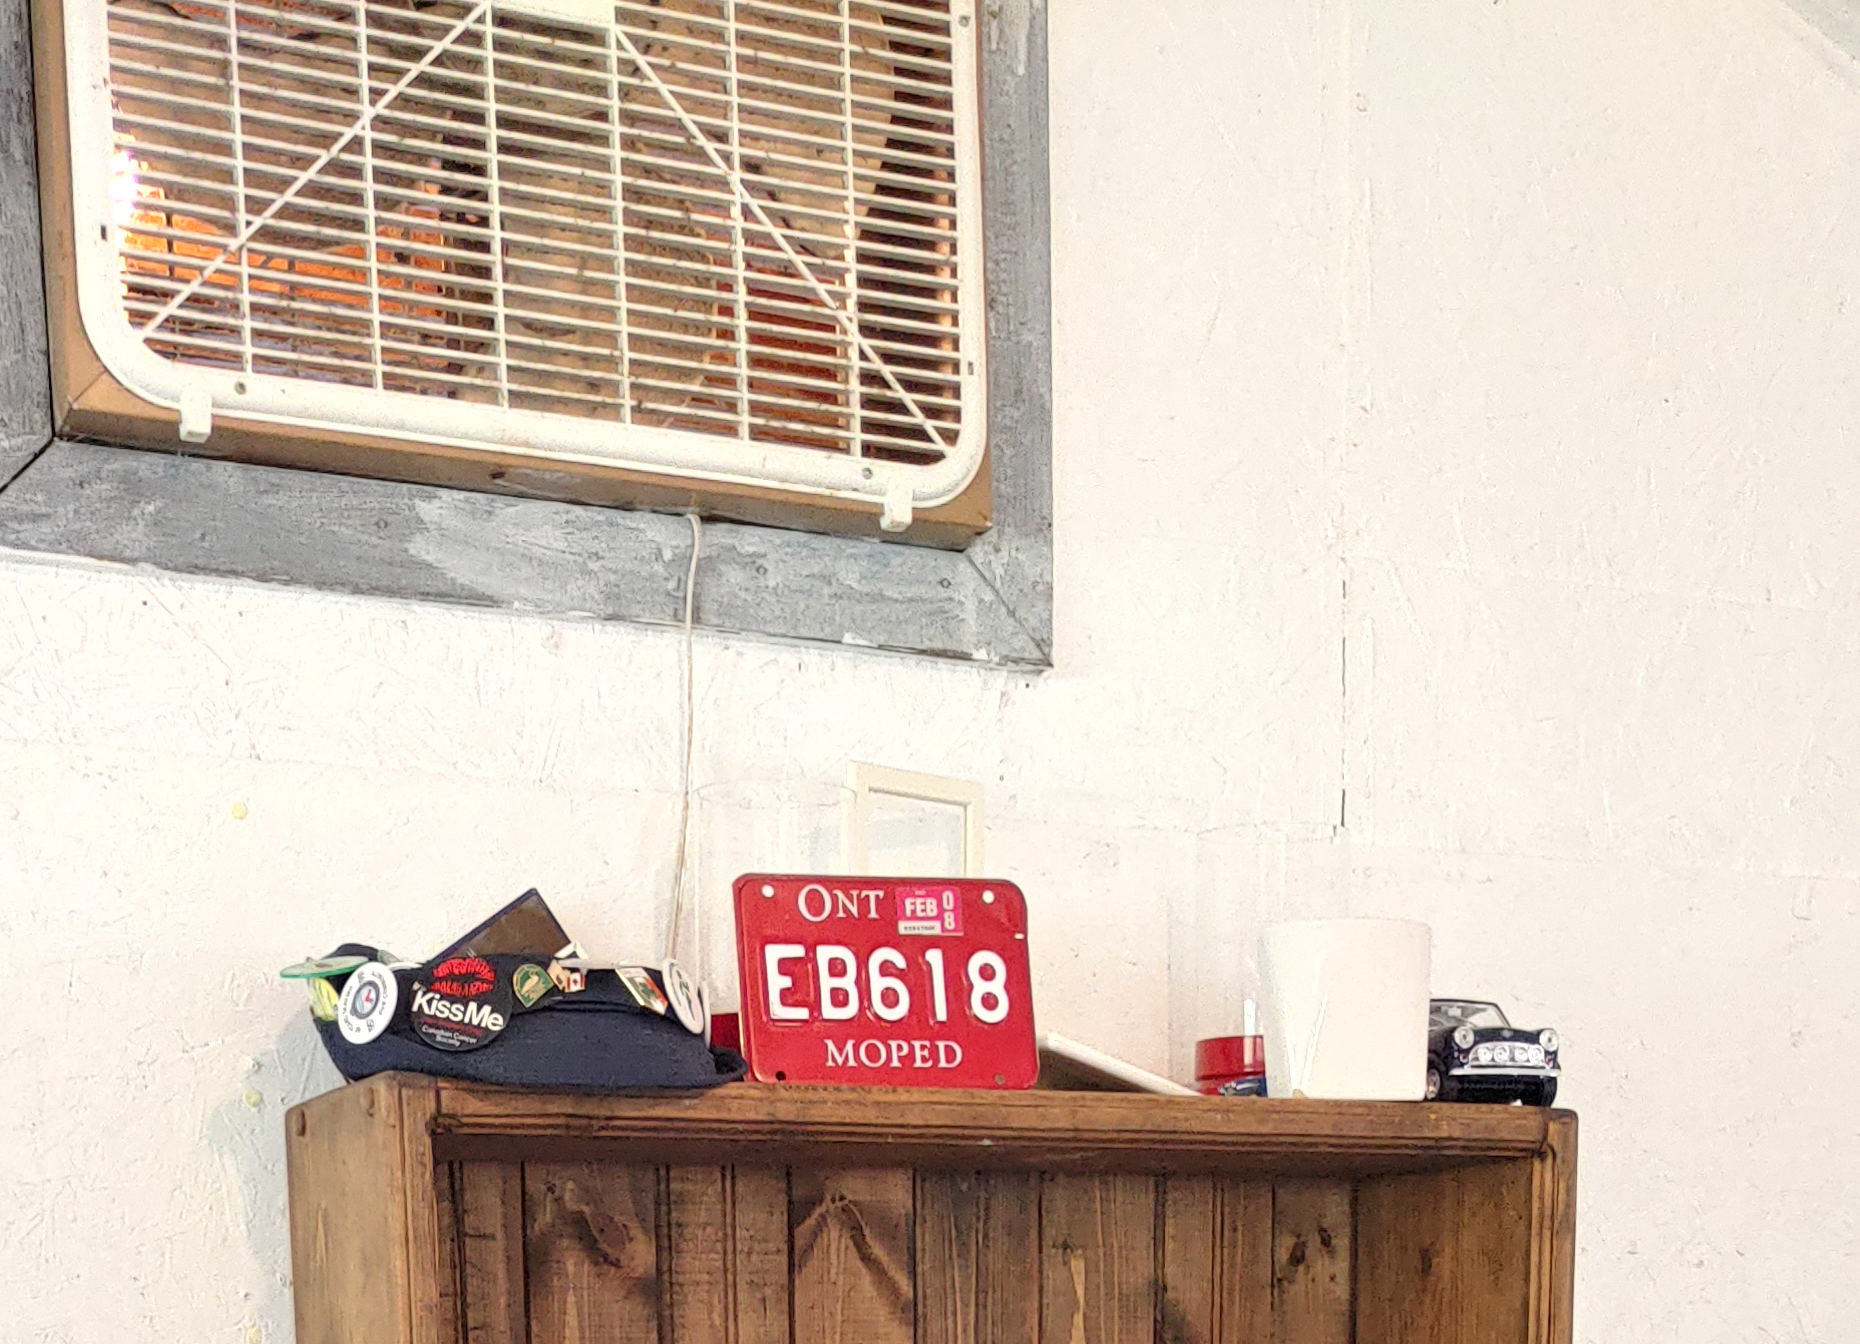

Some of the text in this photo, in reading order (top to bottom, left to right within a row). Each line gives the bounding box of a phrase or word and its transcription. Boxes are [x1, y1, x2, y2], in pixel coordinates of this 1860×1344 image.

[904, 897, 938, 918] FEB
[763, 943, 1010, 1024] EB618
[411, 989, 465, 1022] Kiss
[463, 1001, 505, 1032] Me
[823, 1038, 964, 1069] MOPED
